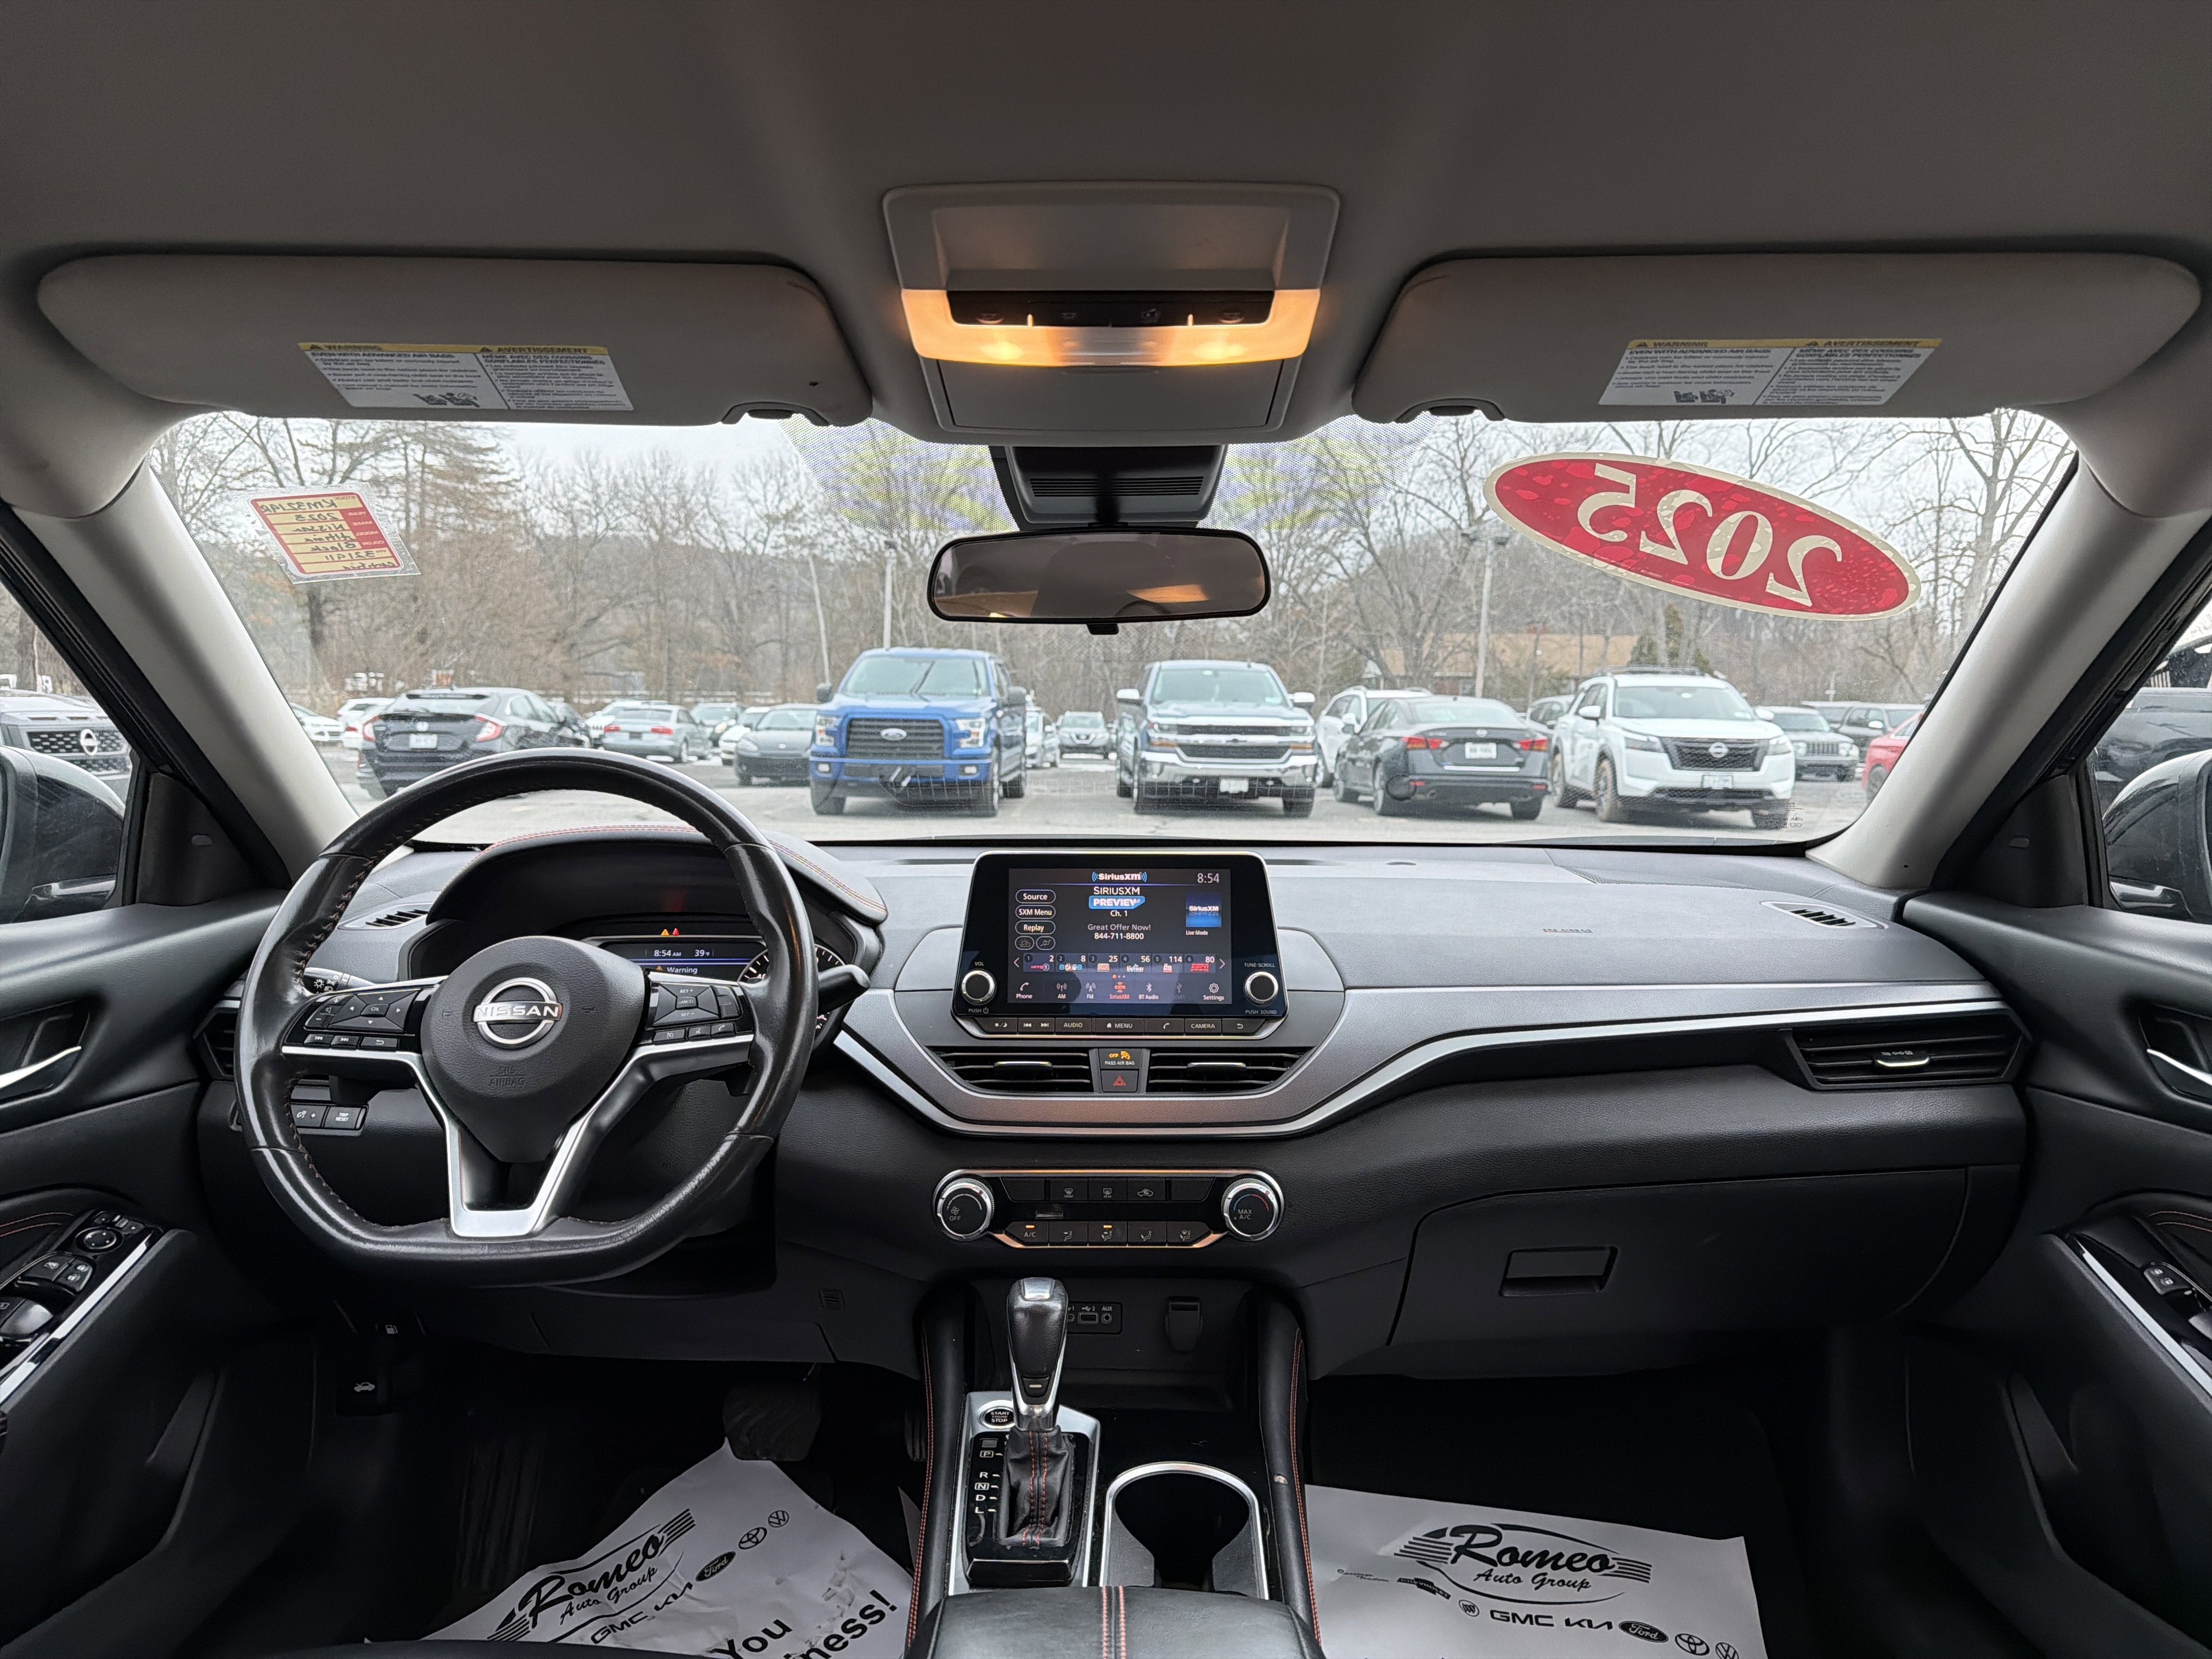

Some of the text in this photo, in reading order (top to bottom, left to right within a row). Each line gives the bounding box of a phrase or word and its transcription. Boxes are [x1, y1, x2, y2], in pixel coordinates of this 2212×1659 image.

[1197, 873, 1220, 884] 8:54
[1093, 887, 1141, 895] SIRIUSXM
[1093, 898, 1141, 907] PREVIEW
[1023, 924, 1045, 933] Replay
[667, 966, 698, 975] Warning
[477, 1005, 559, 1017] NISSAN
[499, 1066, 516, 1075] SRS
[489, 1077, 526, 1087] AIRBAG
[1449, 1524, 1617, 1574] Romeo
[704, 1555, 729, 1578] Ford
[518, 1532, 666, 1629] Romeo
[1473, 1568, 1593, 1592] Auto Group
[560, 1565, 658, 1626] Auto Group
[1489, 1610, 1555, 1627] GMC
[590, 1611, 649, 1645] GMC
[1628, 1623, 1659, 1640] Ford
[712, 1618, 793, 1659] You
